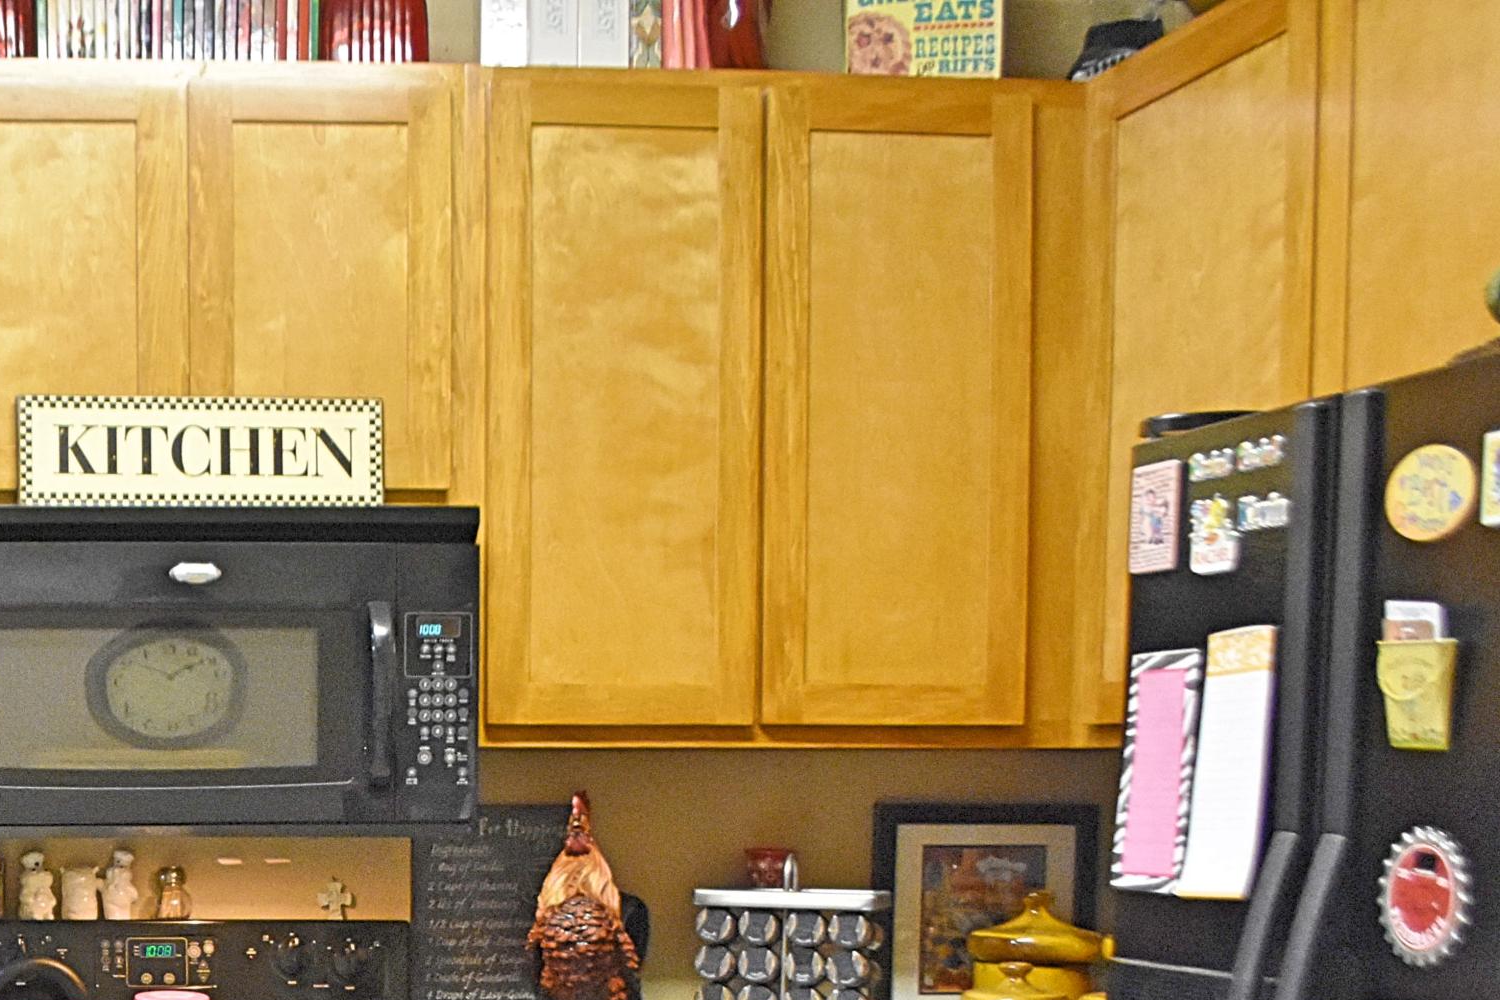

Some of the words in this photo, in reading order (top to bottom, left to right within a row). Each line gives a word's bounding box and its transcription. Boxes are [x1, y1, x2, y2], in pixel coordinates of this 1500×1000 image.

[914, 0, 995, 23] EATS
[915, 34, 996, 59] RECIPES
[939, 58, 995, 73] RIFFS
[53, 423, 357, 478] KITCHEN
